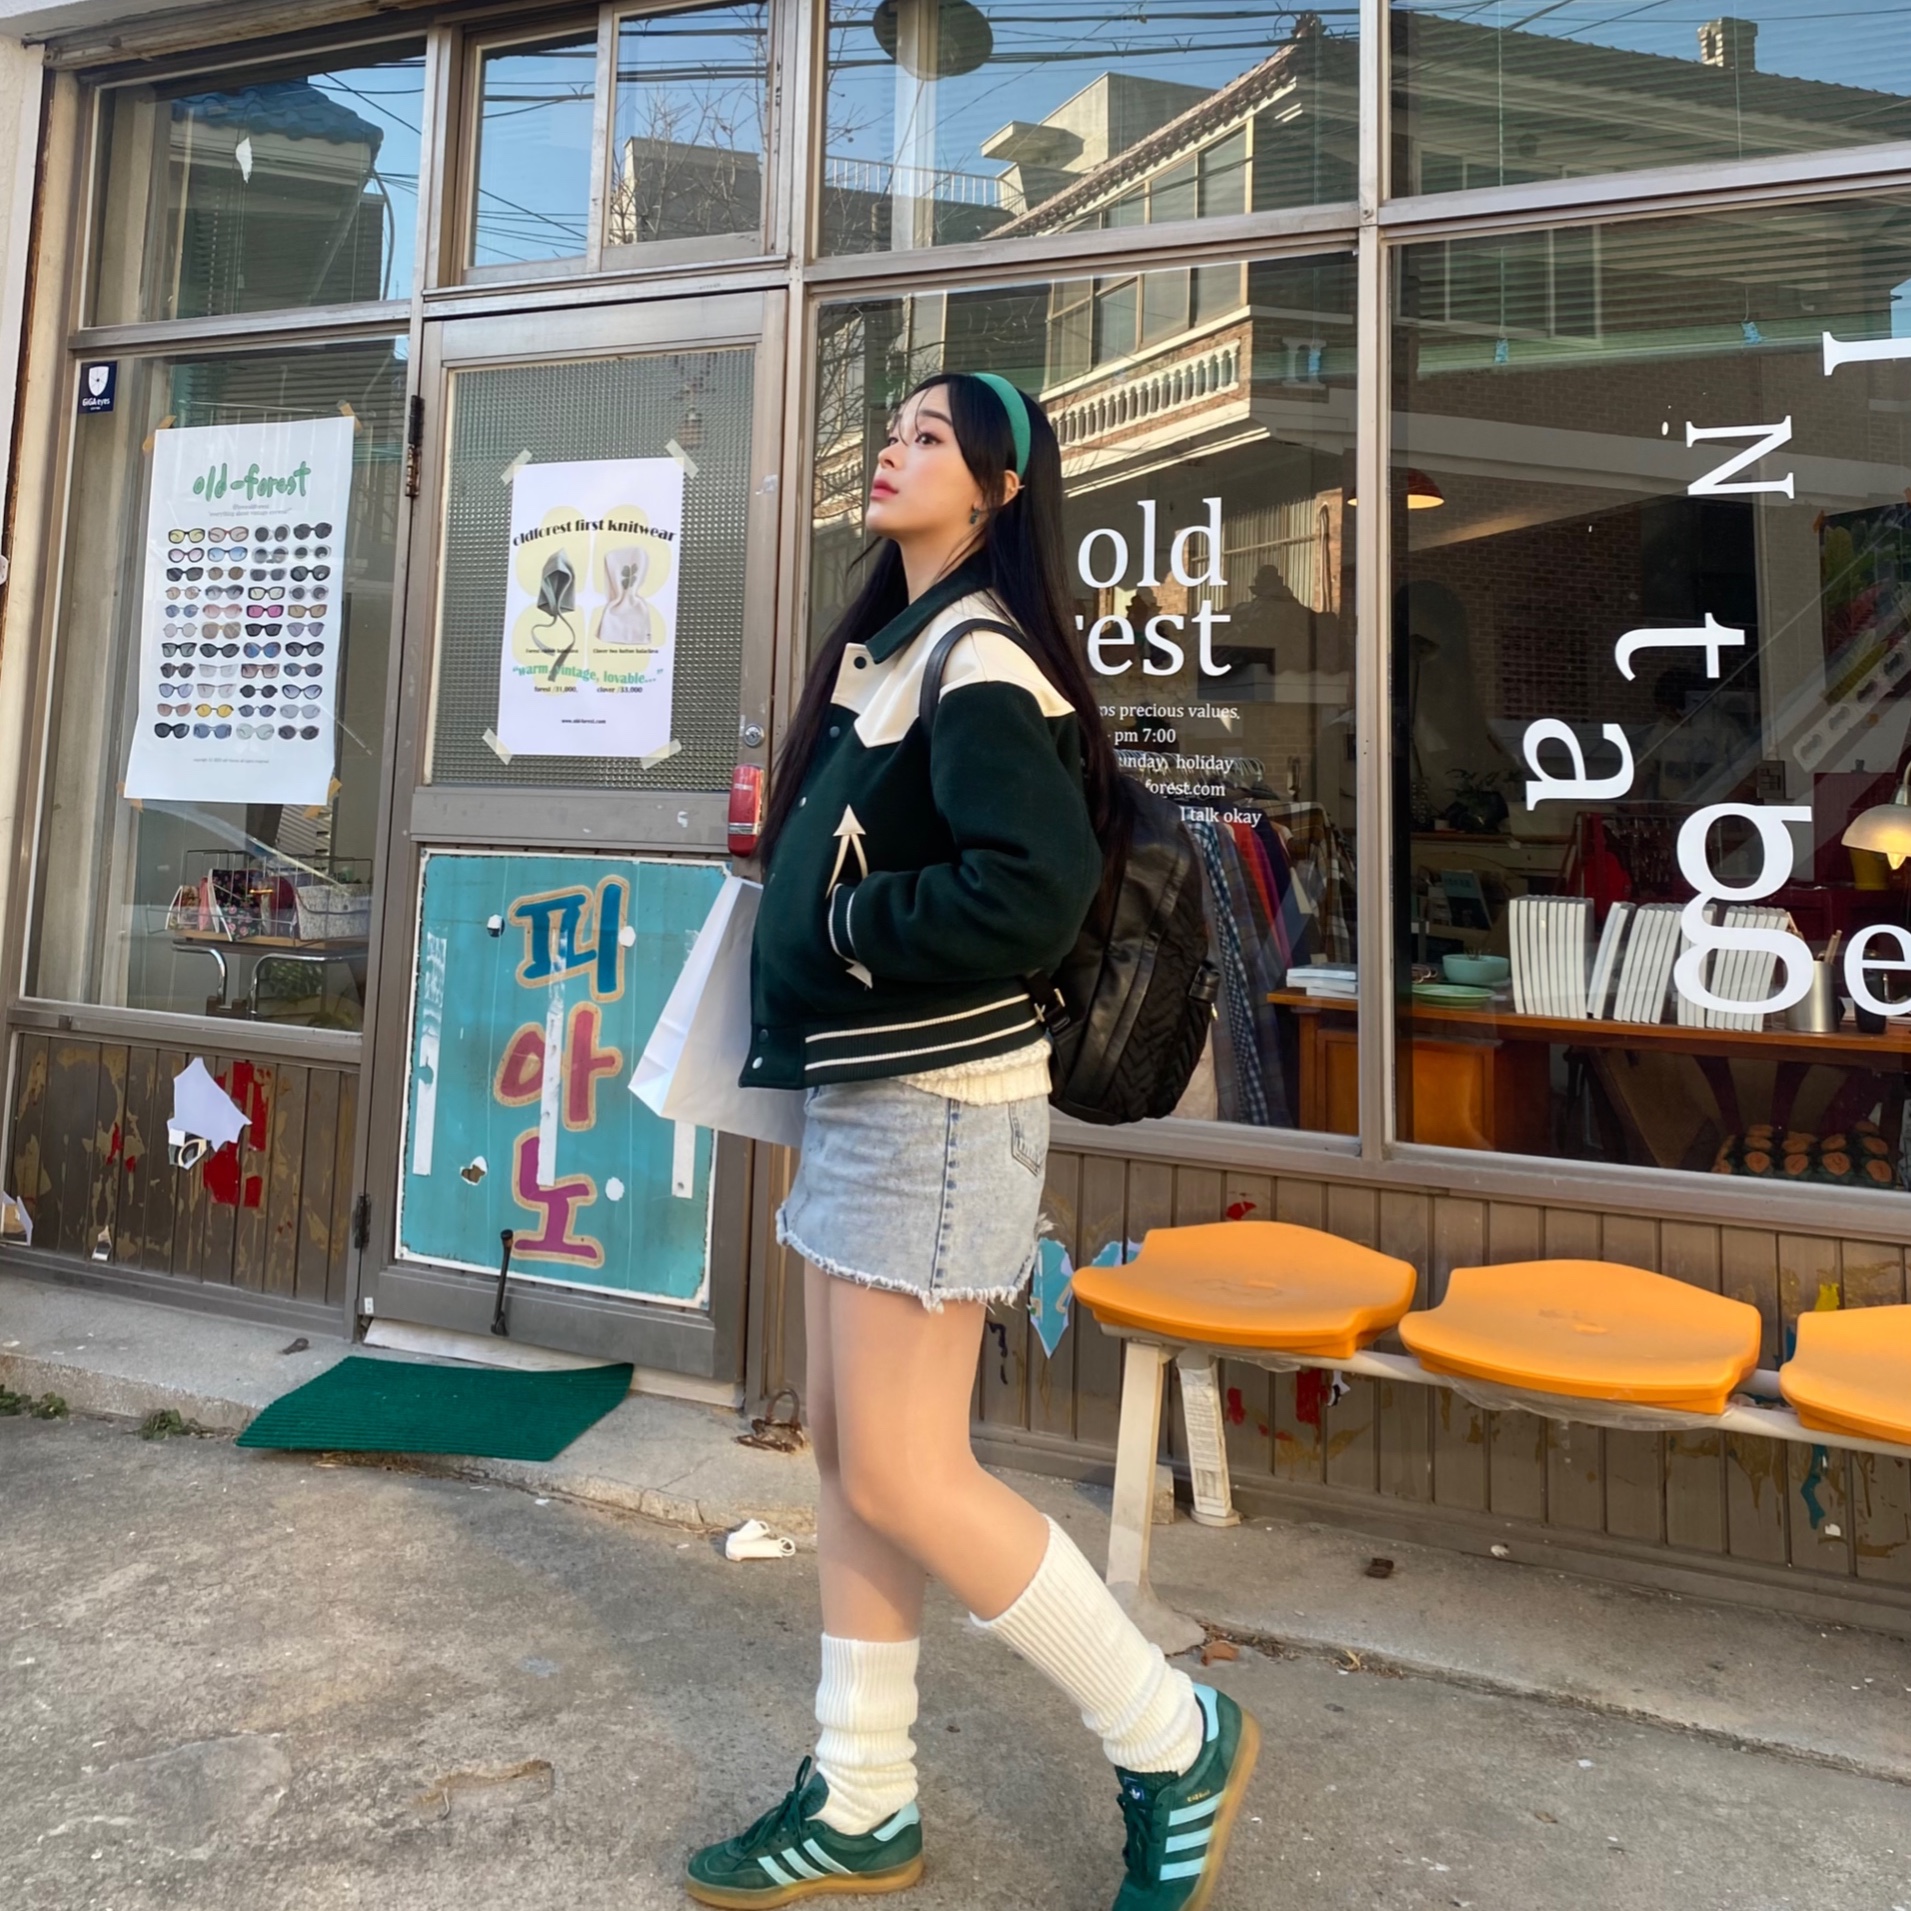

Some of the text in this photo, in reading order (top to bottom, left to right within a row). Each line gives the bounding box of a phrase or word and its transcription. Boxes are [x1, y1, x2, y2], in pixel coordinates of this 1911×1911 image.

[193, 460, 311, 502] old-forest
[513, 519, 678, 547] oldforest first knitwear
[1077, 496, 1228, 589] old
[1075, 599, 1232, 677] est
[1119, 703, 1184, 721] precious
[1187, 703, 1241, 720] values.
[1114, 728, 1177, 746] pm 7:00
[1175, 754, 1234, 775] holiday
[1189, 807, 1220, 823] talk
[1222, 807, 1262, 829] okay
[494, 875, 630, 1268] 피아노
